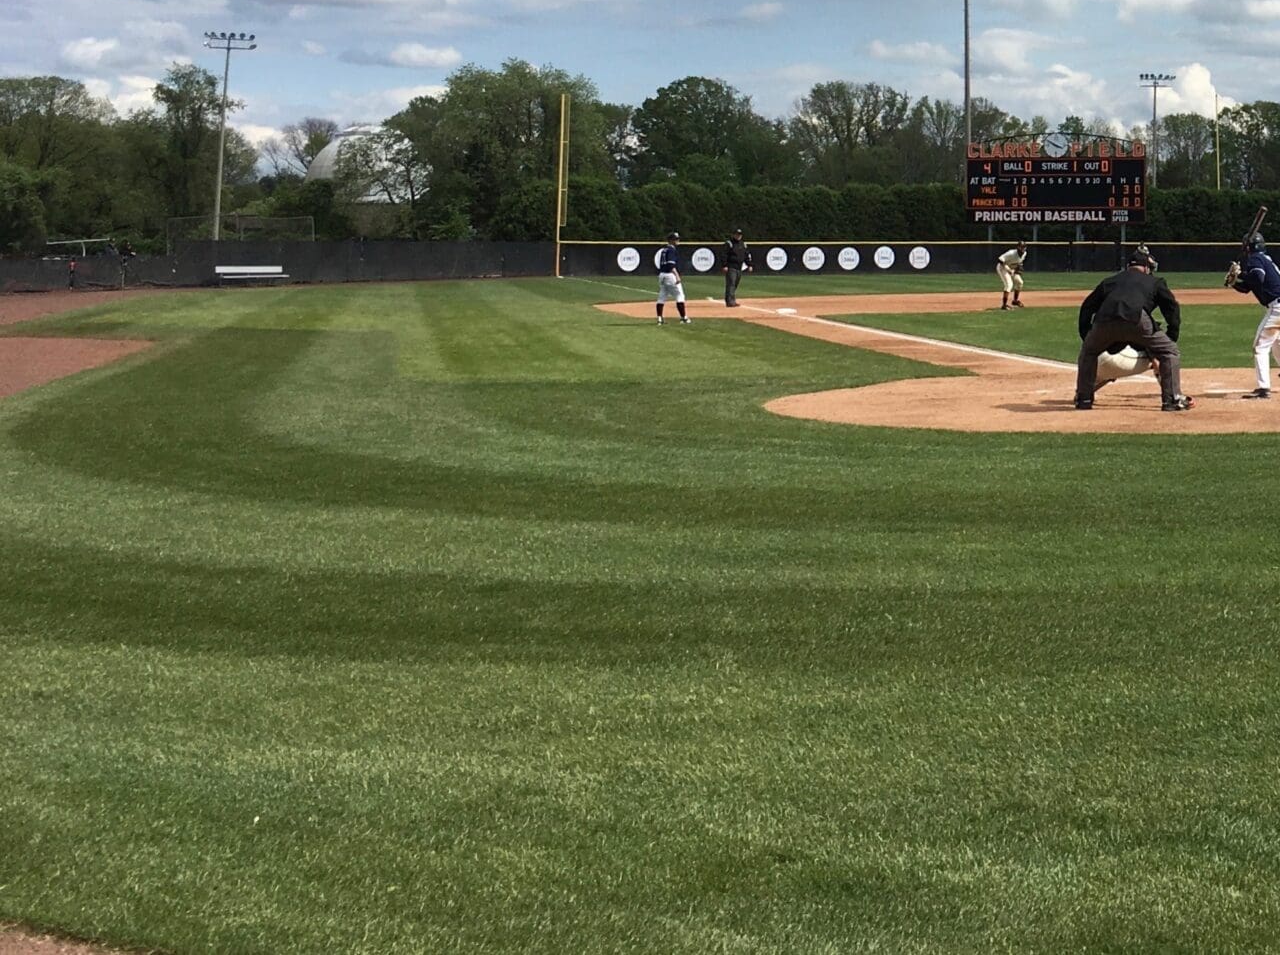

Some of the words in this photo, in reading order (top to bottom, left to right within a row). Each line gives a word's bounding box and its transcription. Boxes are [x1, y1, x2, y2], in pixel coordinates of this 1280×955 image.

[968, 142, 1041, 158] CLARKE
[1070, 140, 1145, 158] FIELD
[984, 163, 991, 173] 4
[1004, 162, 1023, 170] BALL
[1024, 161, 1032, 172] 0
[1042, 162, 1068, 170] STRIKE
[1085, 162, 1099, 170] OUT
[1101, 160, 1108, 172] 0
[1123, 185, 1129, 194] 3
[1135, 185, 1140, 194] 0
[1012, 198, 1018, 206] 0
[1022, 198, 1027, 206] 0
[1109, 198, 1115, 207] 0
[1124, 198, 1129, 207] 0
[975, 211, 1041, 221] PRINCETON
[1045, 211, 1105, 221] BASEBALL
